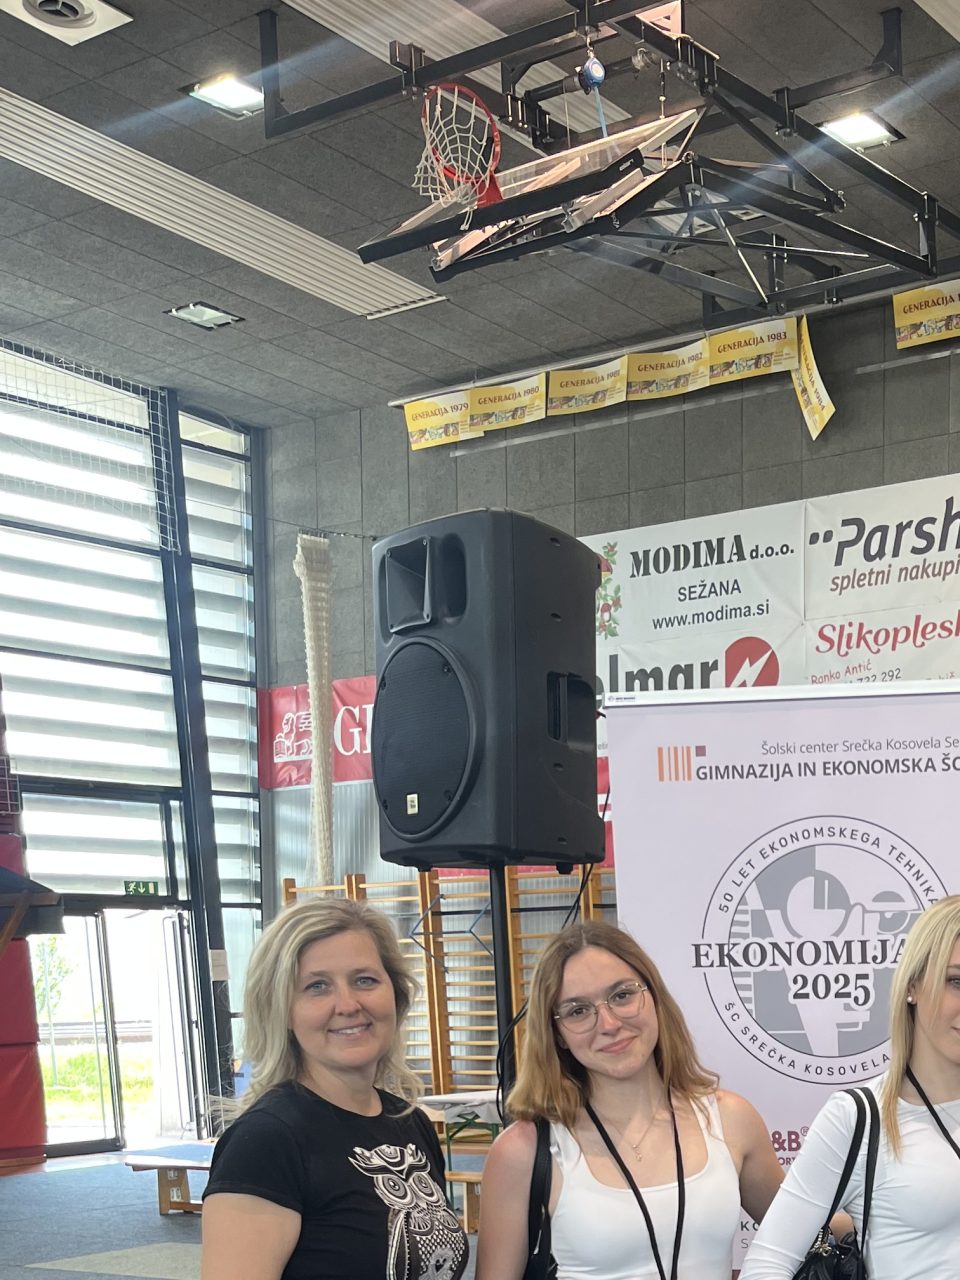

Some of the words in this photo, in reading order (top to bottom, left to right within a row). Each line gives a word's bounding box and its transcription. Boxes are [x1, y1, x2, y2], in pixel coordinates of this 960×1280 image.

[903, 296, 955, 315] GENERACIJA
[717, 336, 764, 354] GENERACIJA
[767, 331, 787, 343] 1983
[637, 357, 685, 372] GENERACIJA
[687, 352, 703, 364] 1982
[559, 376, 605, 389] GENERACIJA
[478, 392, 522, 405] GENERACIJA
[523, 386, 540, 396] 1980
[411, 408, 449, 422] GENERACIJA
[450, 403, 469, 413] 1979
[629, 534, 746, 578] MODIMA
[750, 543, 795, 560] d.o.o.
[677, 579, 741, 602] SEŽANA
[830, 564, 891, 596] spletni
[652, 599, 770, 630] www.modima.si
[761, 739, 796, 755] Šolski
[799, 743, 838, 754] center
[842, 739, 882, 752] Srečka
[886, 736, 941, 751] Kosovela
[696, 762, 794, 781] GIMNAZIJA
[798, 761, 816, 777] IN
[822, 757, 937, 776] EKONOMSKA
[718, 892, 734, 913] 50
[731, 859, 756, 888] LET
[759, 827, 881, 860] EKONOMSKEGA
[792, 973, 871, 1007] 2025
[741, 1026, 796, 1070] SREČKA
[804, 1052, 890, 1076] KOSOVELA
